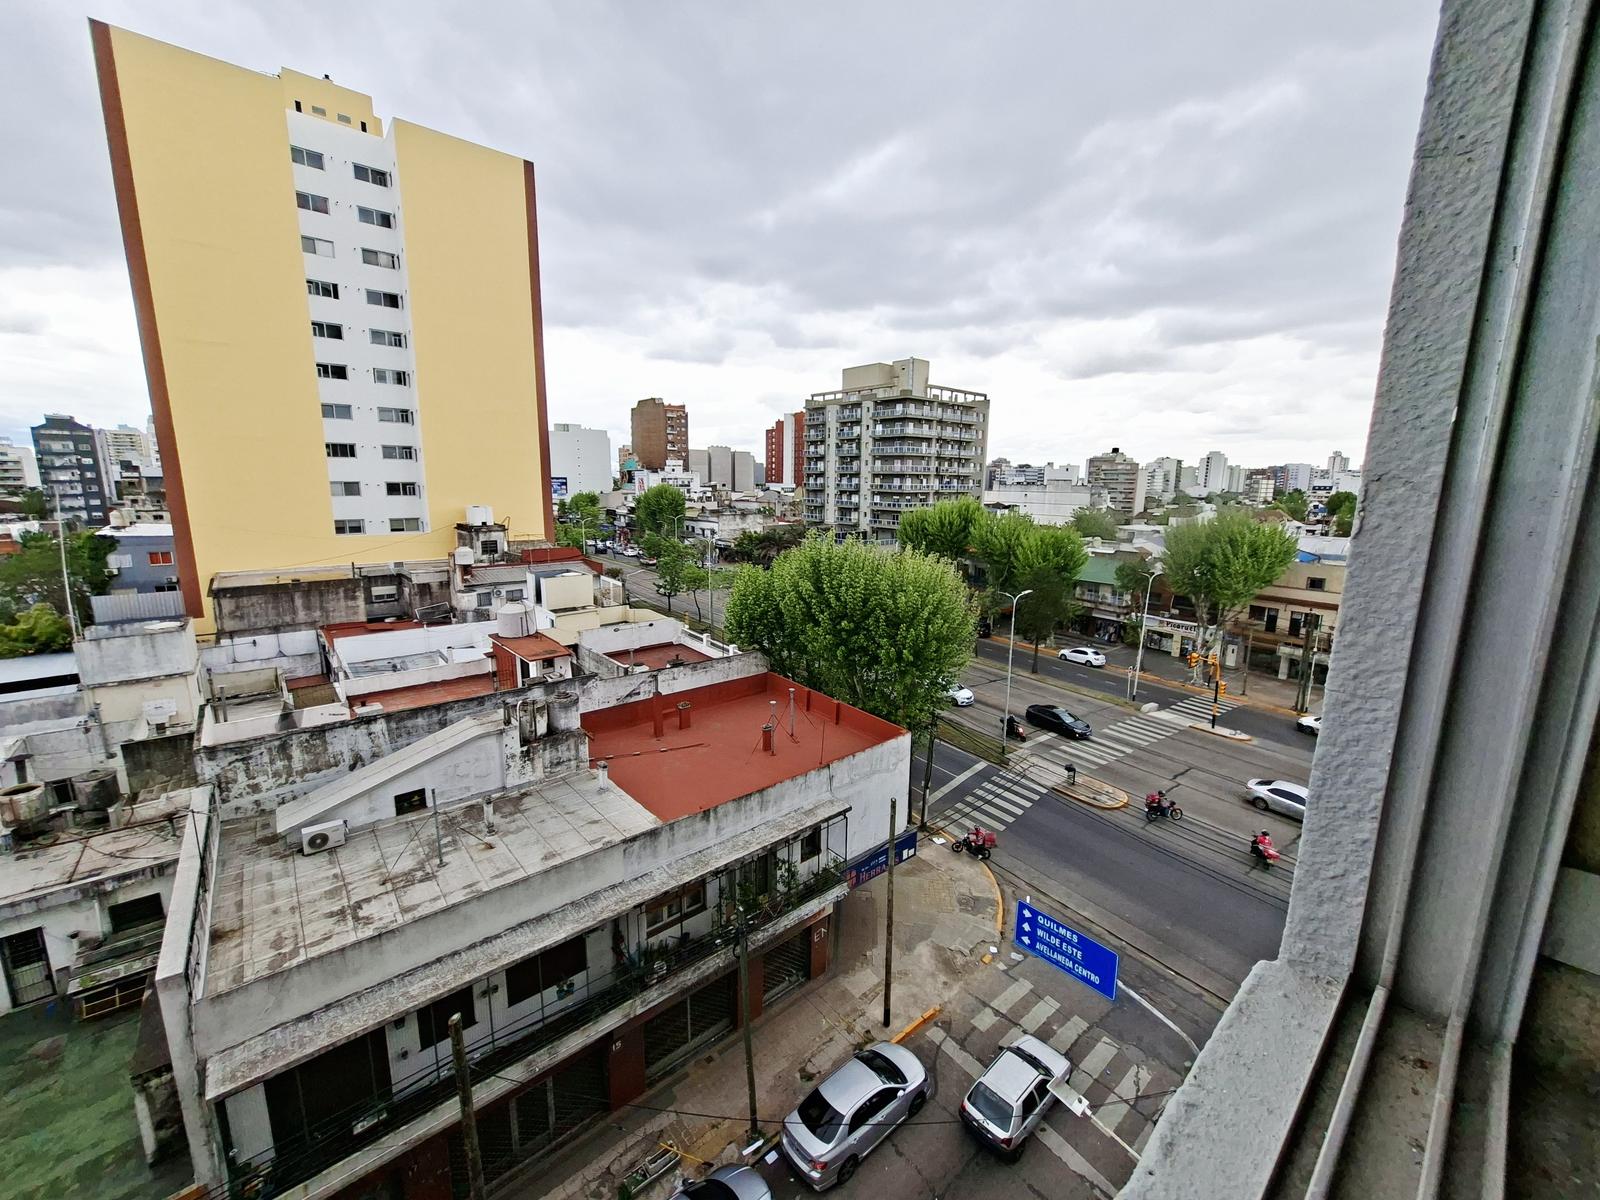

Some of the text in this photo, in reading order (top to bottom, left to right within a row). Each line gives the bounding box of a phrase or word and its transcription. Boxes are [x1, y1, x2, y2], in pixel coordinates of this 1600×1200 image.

[1036, 928, 1083, 960] WILDE ESTE
[1037, 915, 1078, 943] QUILMES
[1035, 942, 1100, 985] AVELLANEDA CENTRO
